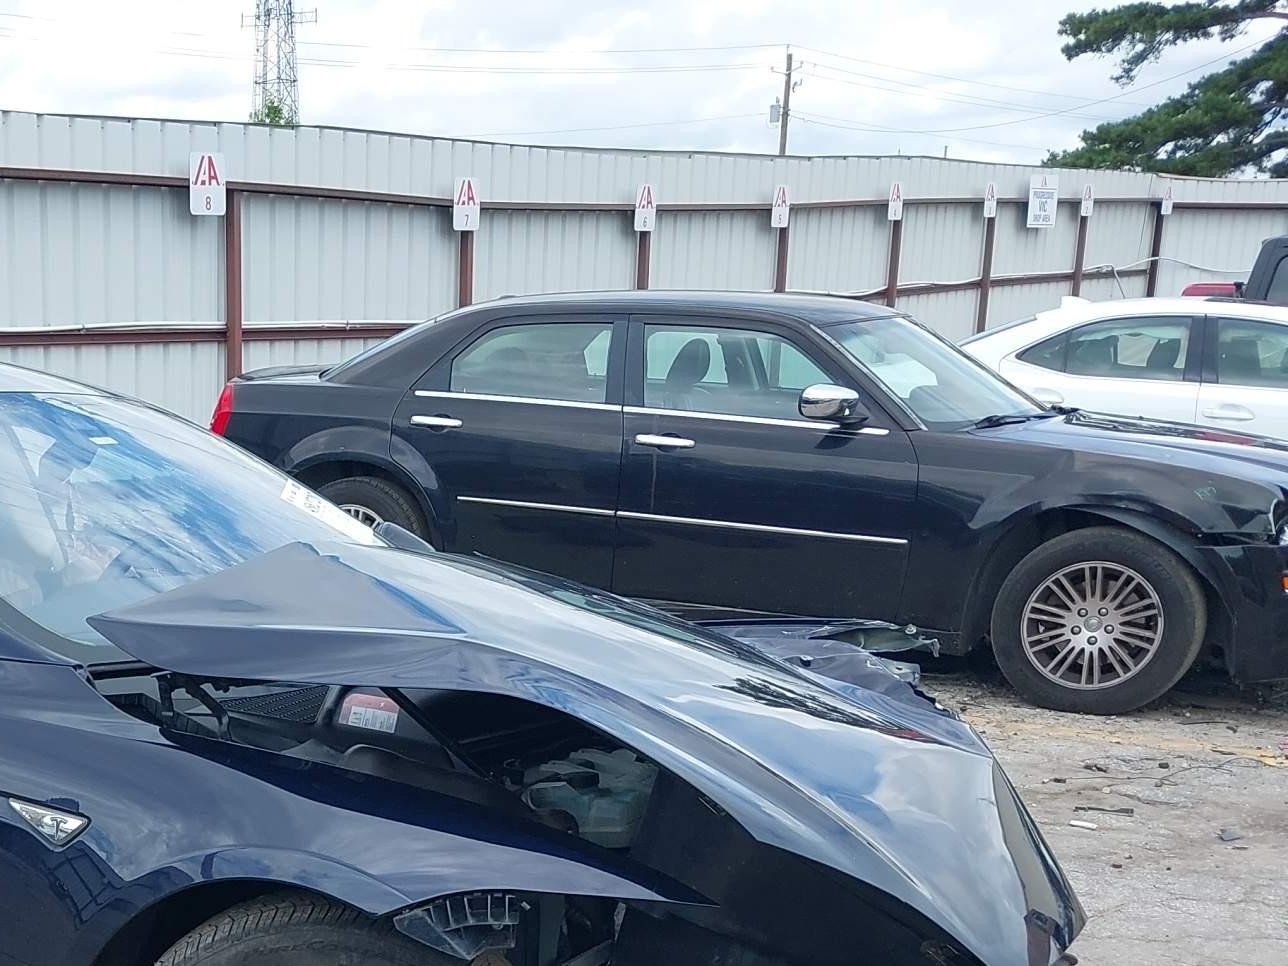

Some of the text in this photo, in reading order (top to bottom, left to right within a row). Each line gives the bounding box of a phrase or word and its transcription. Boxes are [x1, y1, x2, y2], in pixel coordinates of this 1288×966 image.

[205, 196, 212, 211] 8
[464, 214, 470, 226] 7
[642, 216, 648, 228] 6
[778, 214, 782, 225] 5
